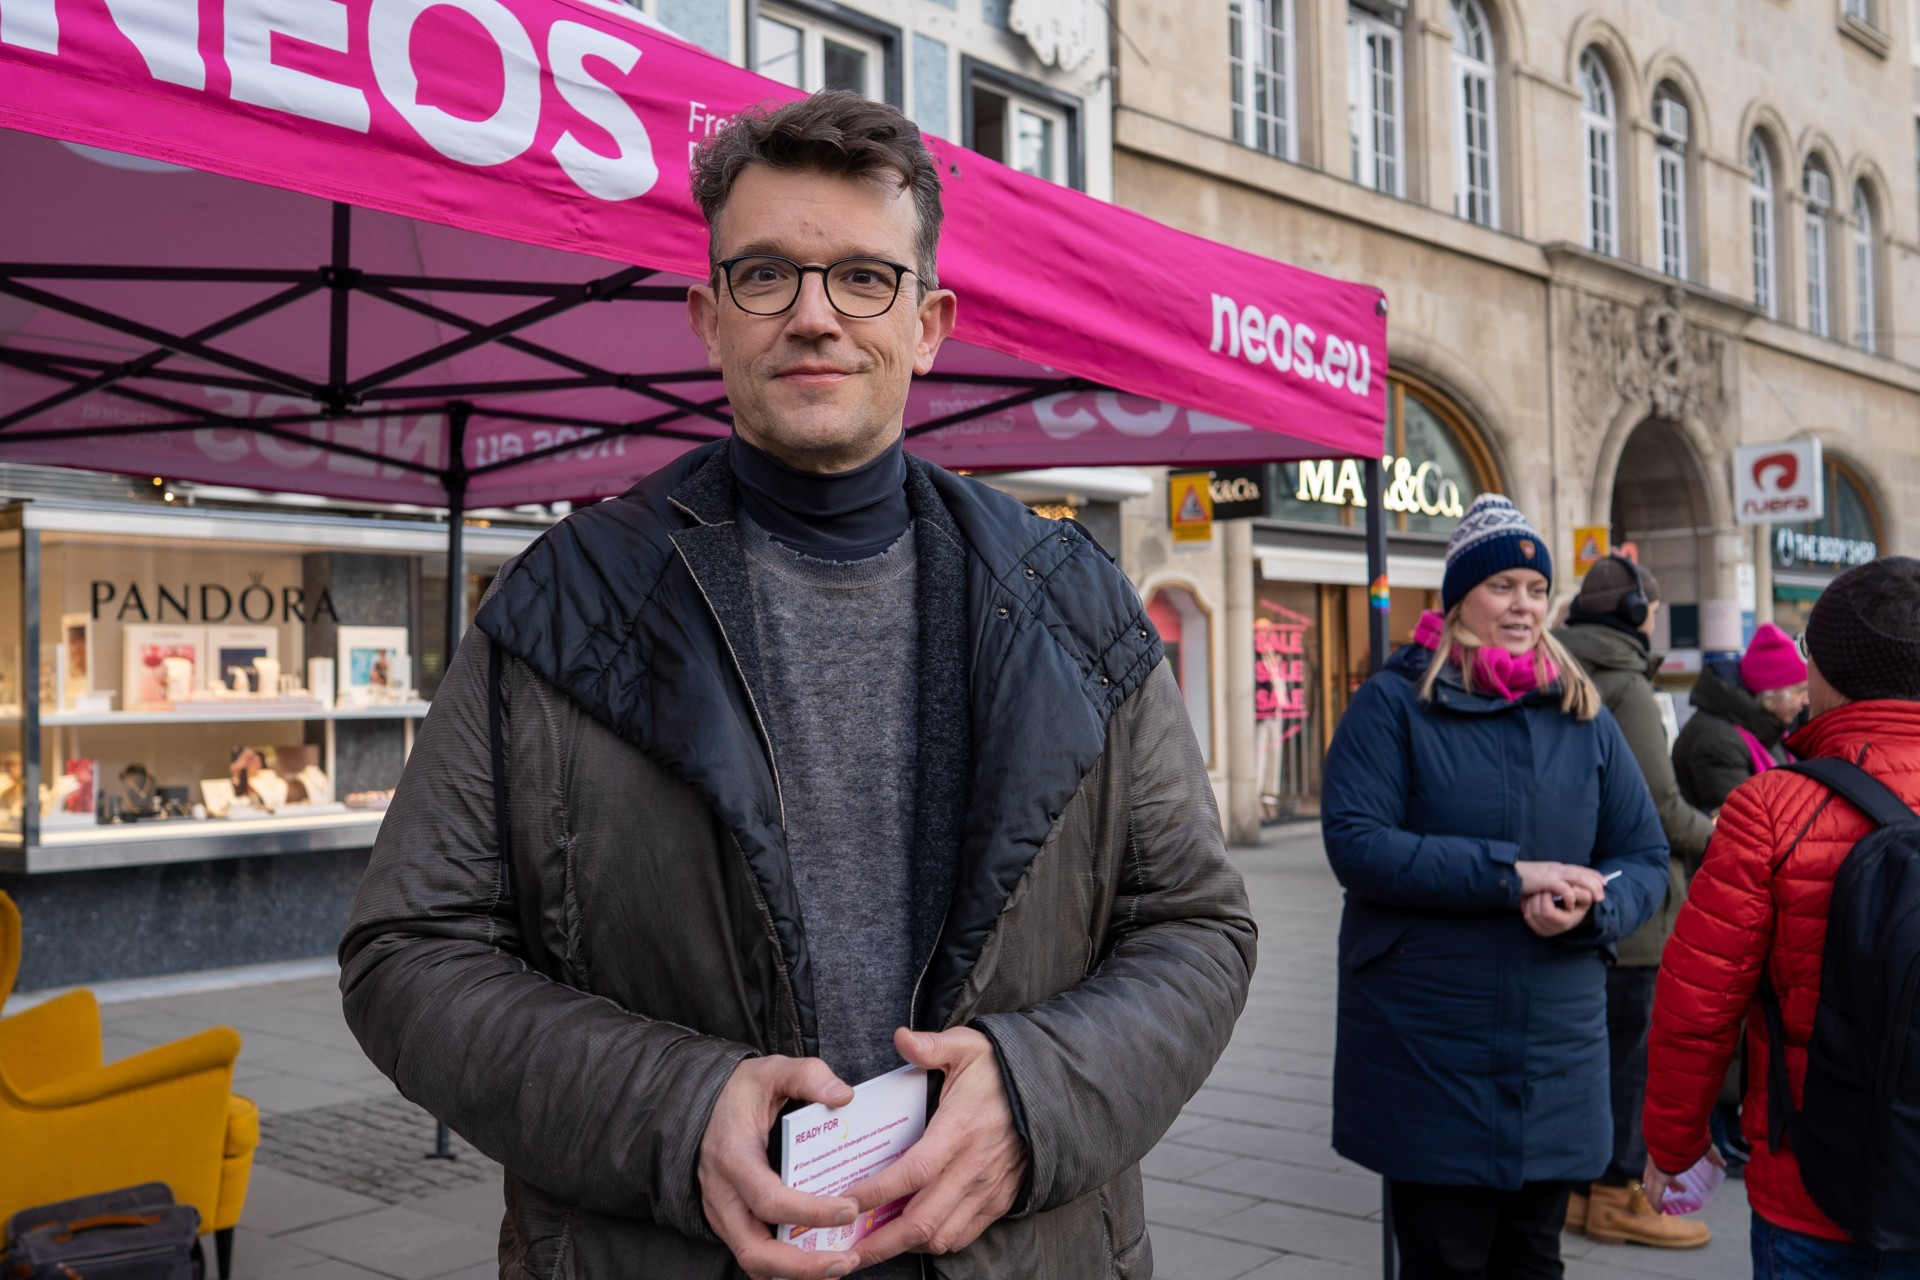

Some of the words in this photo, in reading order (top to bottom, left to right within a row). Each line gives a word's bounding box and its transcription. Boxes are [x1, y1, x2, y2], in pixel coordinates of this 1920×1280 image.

[1209, 292, 1371, 397] neos.eu
[1743, 495, 1810, 516] ruefa
[1794, 533, 1817, 561] THE
[1818, 535, 1846, 563] BODY
[1847, 539, 1876, 565] SHOP
[90, 578, 340, 624] PANDORA
[1255, 631, 1303, 653] SALE
[1255, 660, 1303, 682] SLE
[795, 1125, 822, 1145] READY
[823, 1118, 839, 1134] FOR
